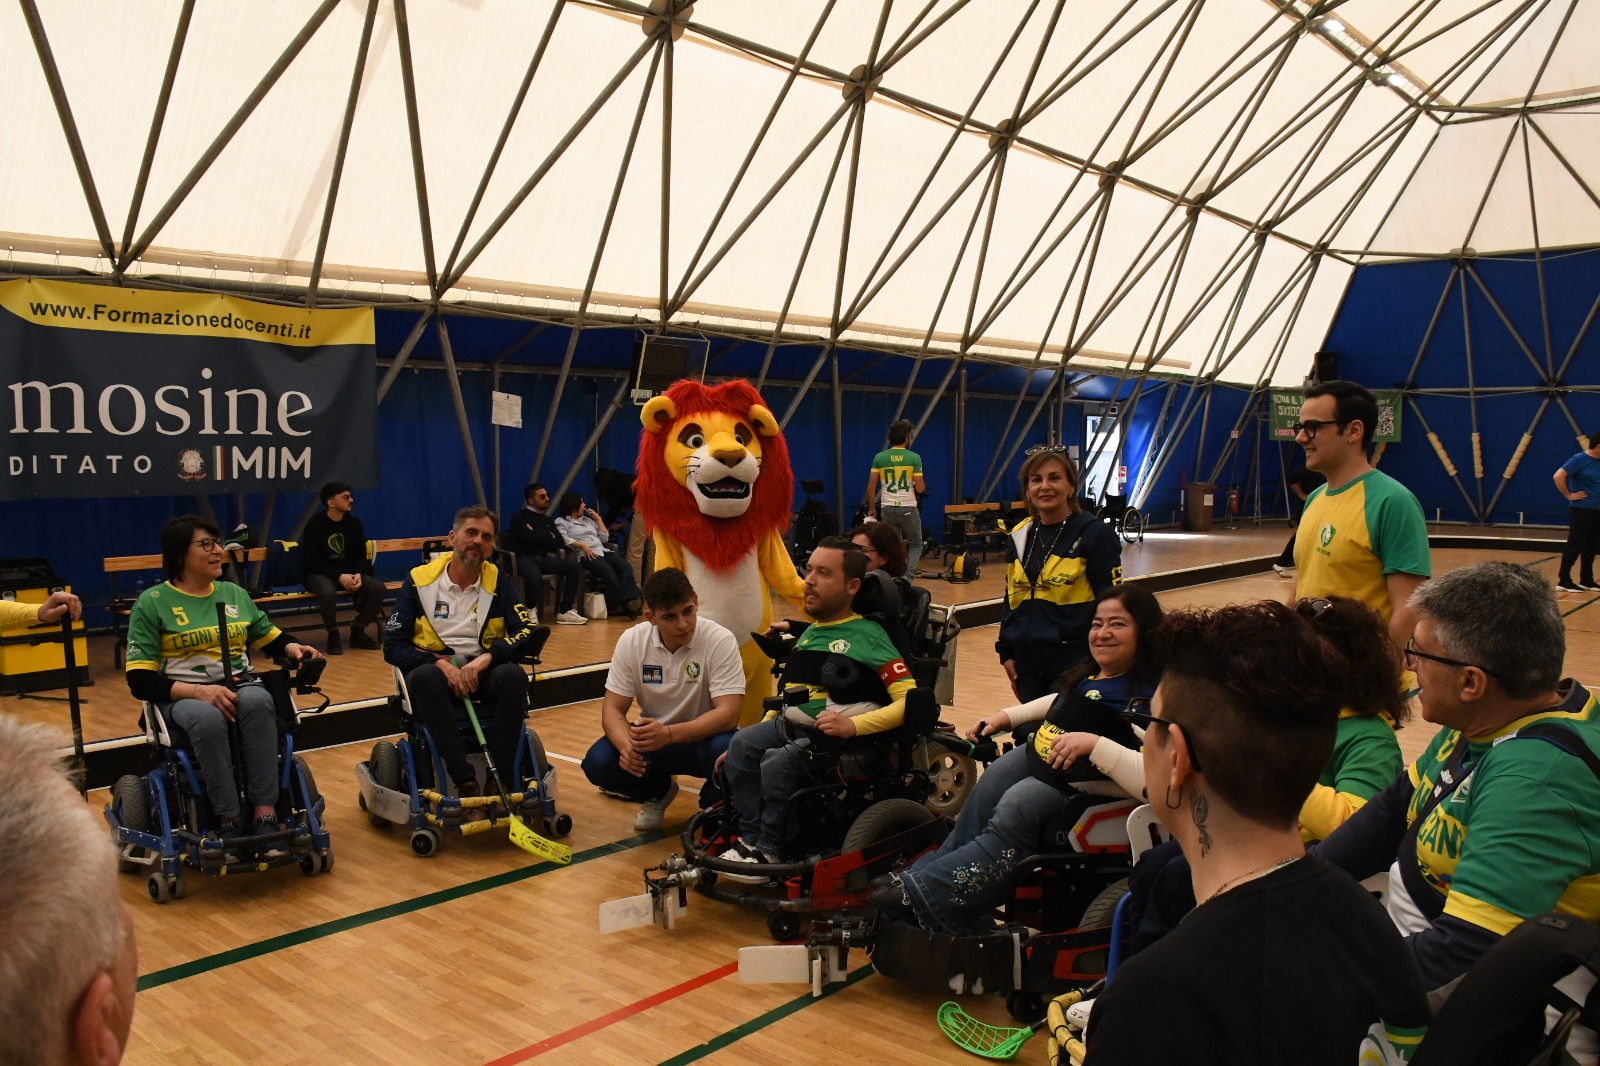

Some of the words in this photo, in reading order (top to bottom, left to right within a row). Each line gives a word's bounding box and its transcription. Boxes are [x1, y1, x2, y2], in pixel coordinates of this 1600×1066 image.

[29, 301, 312, 339] www.Formazionedocenti.it
[8, 367, 313, 436] mosine
[231, 446, 312, 479] MIM
[884, 468, 910, 493] 24
[172, 606, 190, 626] 5
[172, 628, 213, 650] LEONI
[892, 662, 907, 674] C
